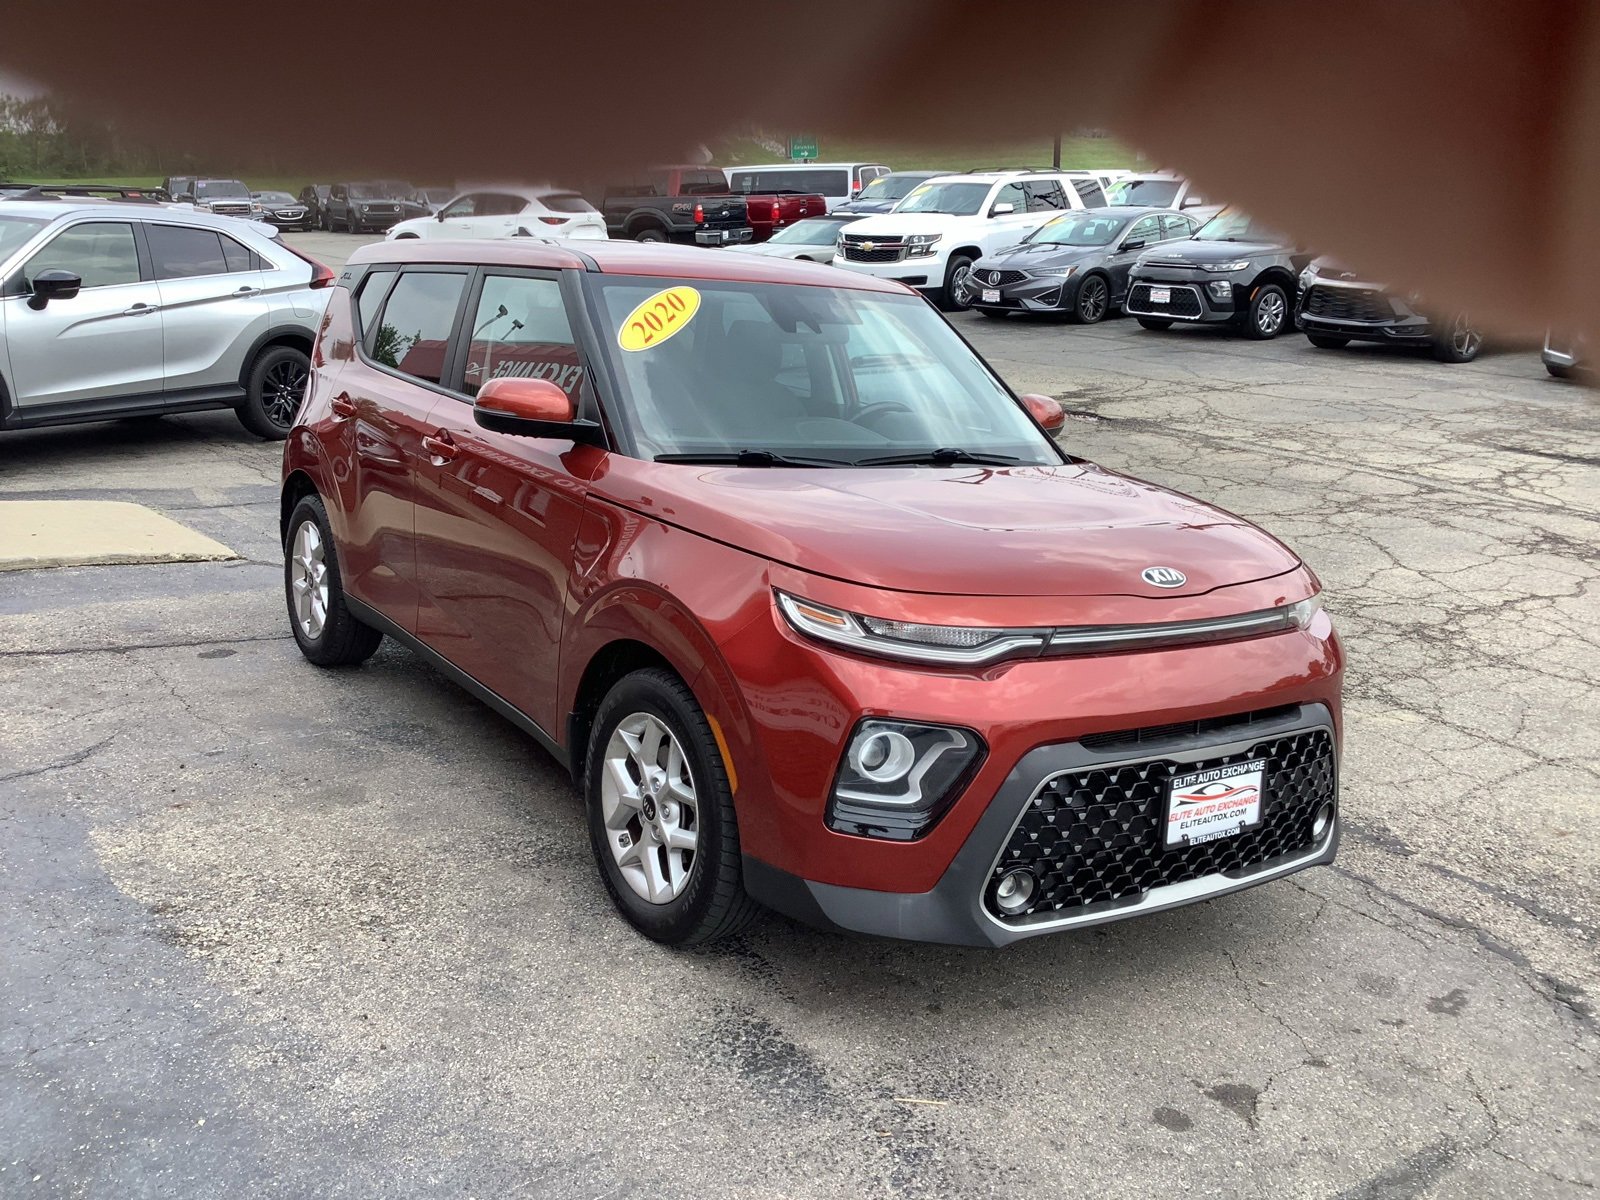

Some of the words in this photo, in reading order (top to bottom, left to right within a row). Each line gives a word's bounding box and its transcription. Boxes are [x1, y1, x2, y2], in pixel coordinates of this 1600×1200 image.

[631, 292, 686, 343] 2020
[1145, 568, 1184, 584] KIA
[1173, 775, 1197, 789] ELITE
[1197, 769, 1220, 783] AUTO
[1221, 760, 1265, 777] EXCHANGE
[1169, 809, 1194, 823] ELITE
[1193, 804, 1216, 817] AUTO
[1217, 794, 1258, 811] EXCHANGE
[1180, 808, 1247, 829] ELITEAUTOX.COM
[1189, 827, 1240, 846] ELITEAUTOX.COM
